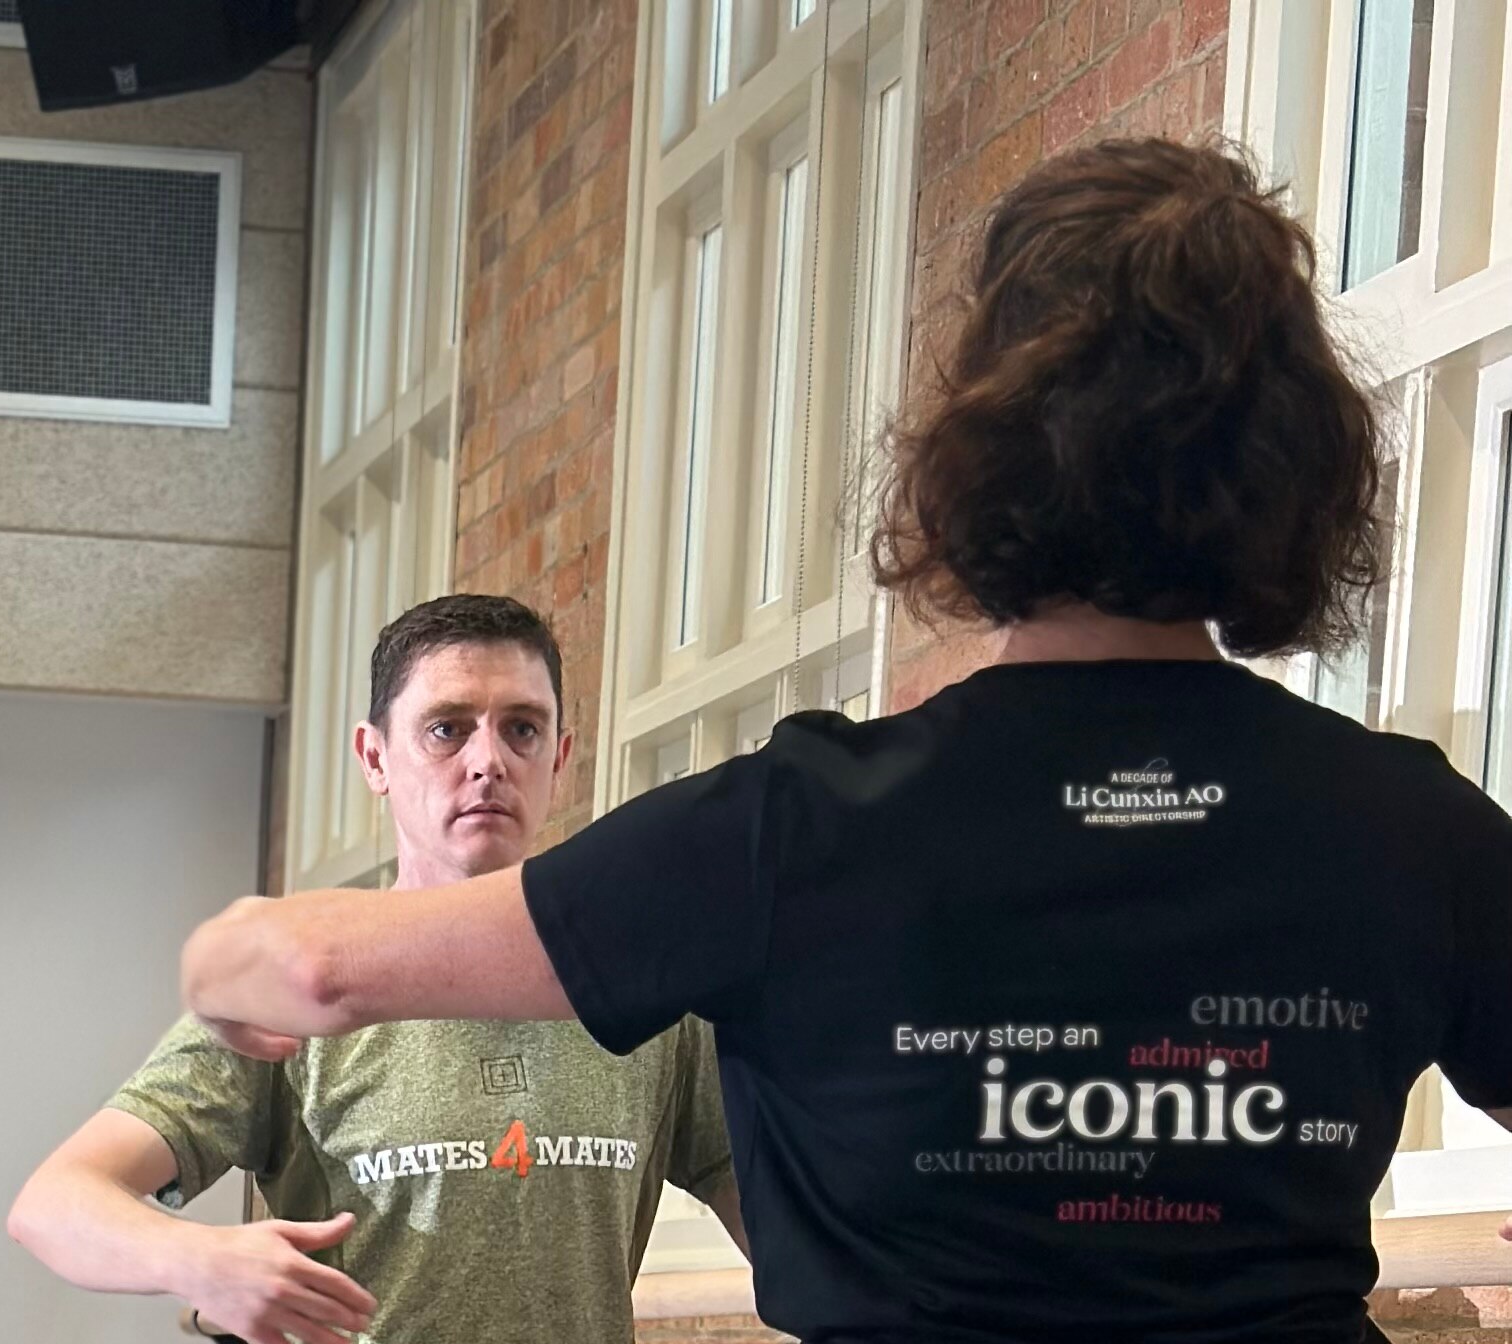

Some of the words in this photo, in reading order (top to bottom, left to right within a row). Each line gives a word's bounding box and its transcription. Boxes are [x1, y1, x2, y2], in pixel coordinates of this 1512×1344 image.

[1111, 773, 1118, 783] A
[1120, 773, 1158, 784] DECADE
[1160, 773, 1173, 784] OF
[1065, 786, 1087, 807] Li
[1092, 788, 1179, 808] Cunxin
[1185, 785, 1224, 805] AO
[1084, 812, 1130, 824] ARTISTIC
[1190, 987, 1369, 1030] emotive
[894, 1027, 980, 1054] Every
[988, 1024, 1055, 1052] step
[1063, 1025, 1099, 1047] an
[979, 1057, 1287, 1144] iconic
[1299, 1119, 1359, 1149] story
[915, 1143, 1156, 1179] extraordinary
[1056, 1193, 1223, 1224] ambitious
